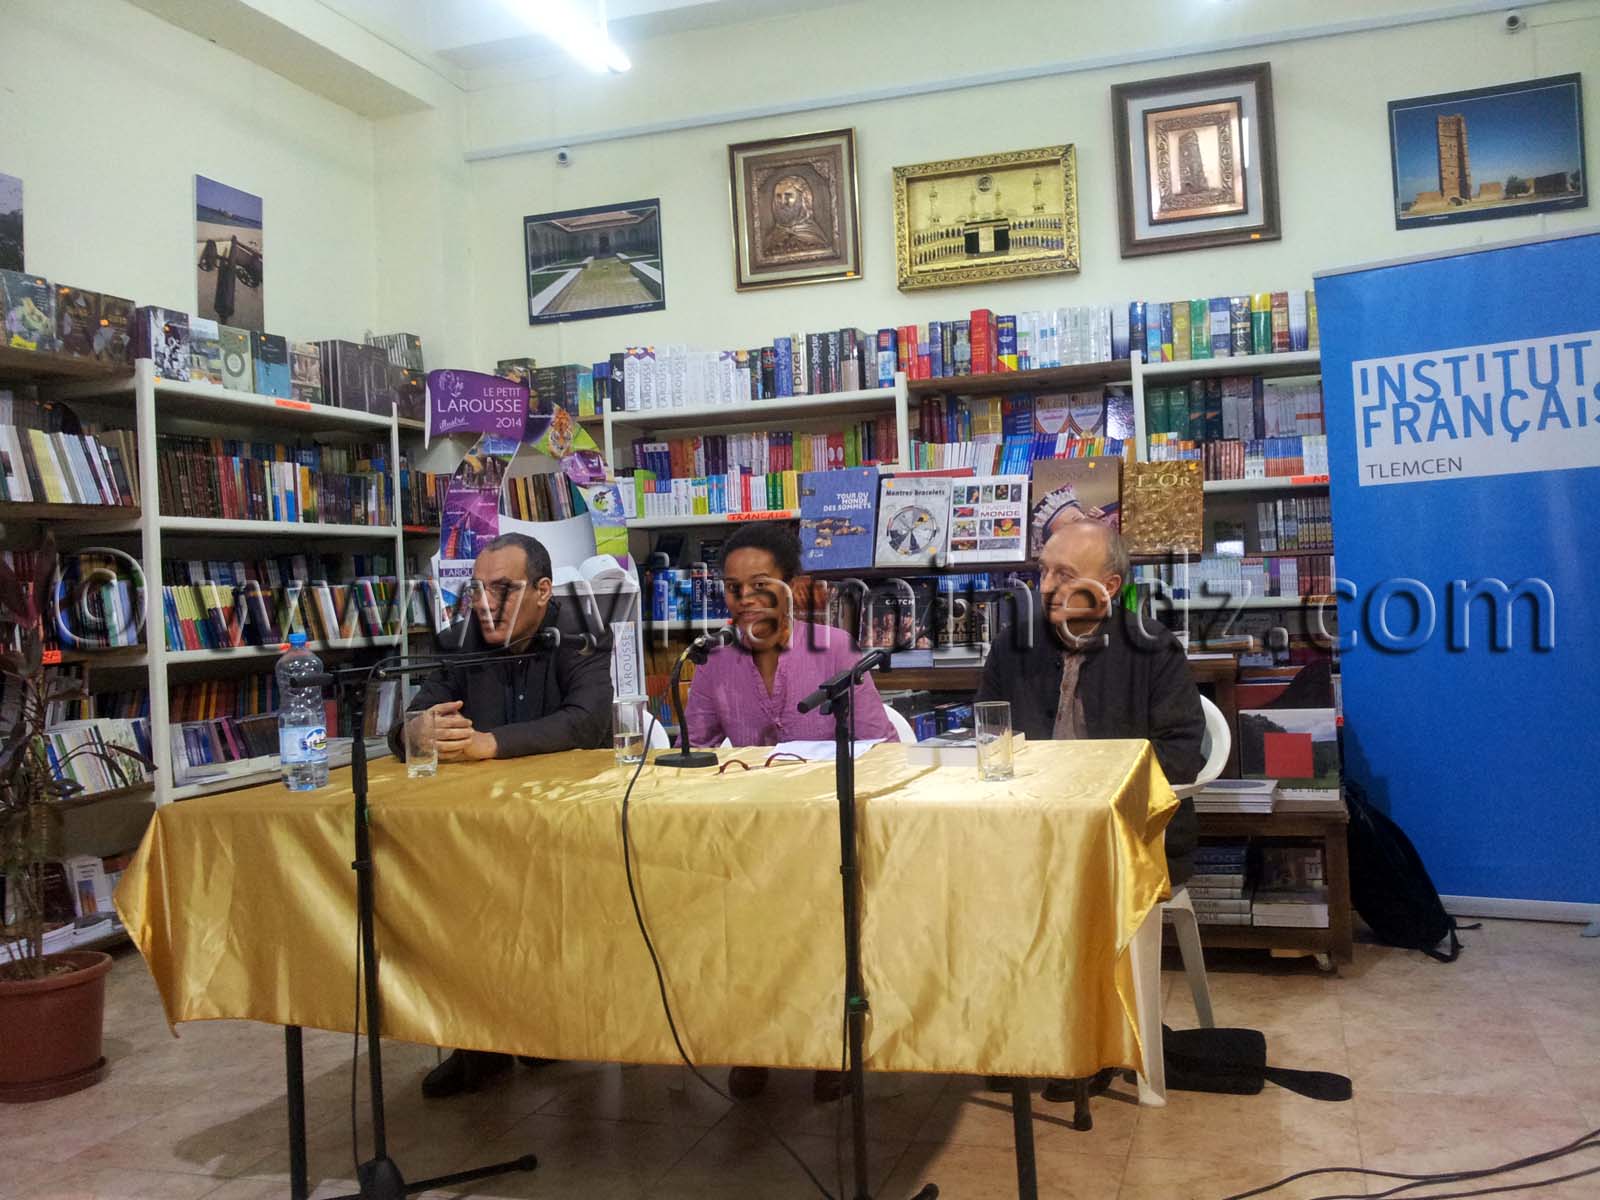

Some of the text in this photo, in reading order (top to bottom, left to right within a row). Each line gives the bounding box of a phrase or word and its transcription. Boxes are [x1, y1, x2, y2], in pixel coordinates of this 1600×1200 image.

[1360, 340, 1593, 403] INSTITUT
[483, 387, 521, 397] LE PETIT
[437, 399, 522, 413] LAROUSSE
[495, 417, 522, 428] 2014
[1361, 387, 1600, 448] FRANÇAI
[1366, 456, 1463, 480] TLEMCEN
[980, 510, 1021, 518] MONDE
[885, 598, 915, 606] CATCH
[621, 634, 634, 695] LAROUSSE
